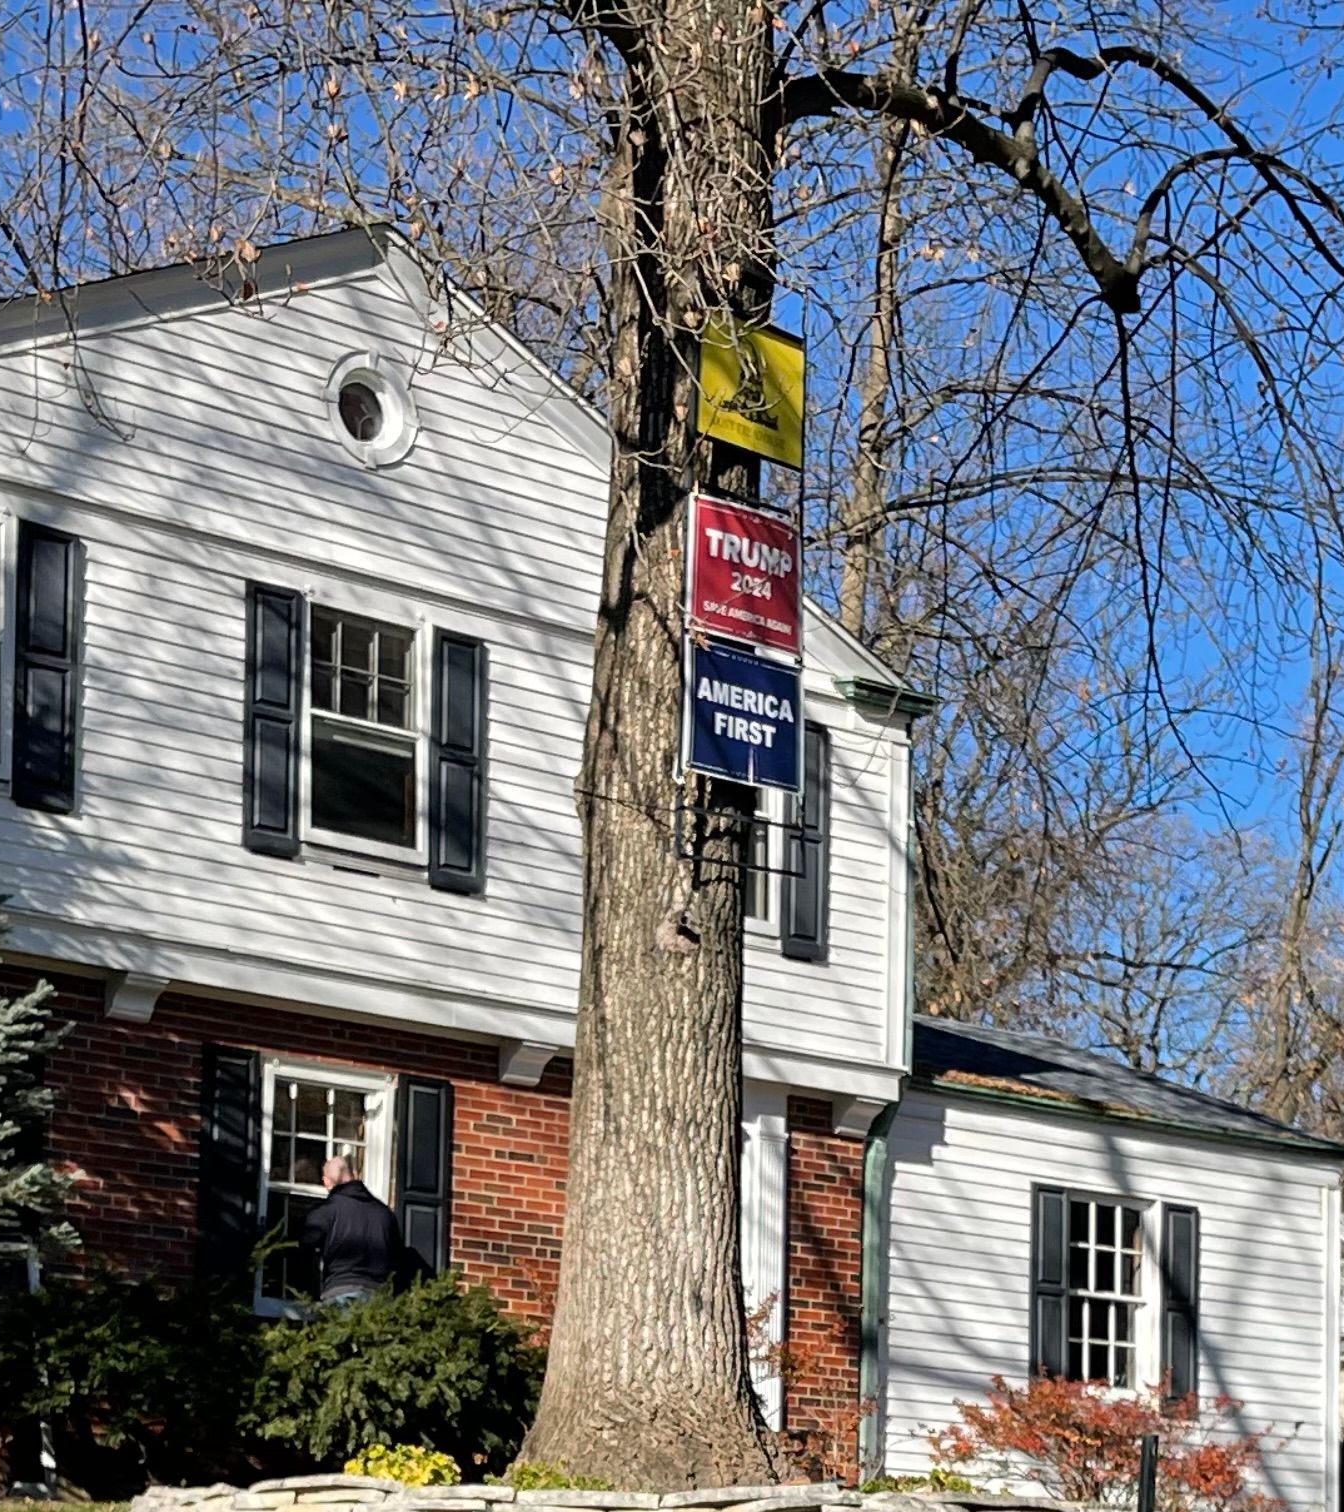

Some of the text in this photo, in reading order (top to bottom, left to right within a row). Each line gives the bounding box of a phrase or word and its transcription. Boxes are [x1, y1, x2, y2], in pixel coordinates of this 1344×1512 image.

[704, 527, 793, 578] TRUMP
[730, 571, 772, 600] 2024
[697, 677, 794, 723] AMERICA
[714, 711, 776, 748] FIRST
